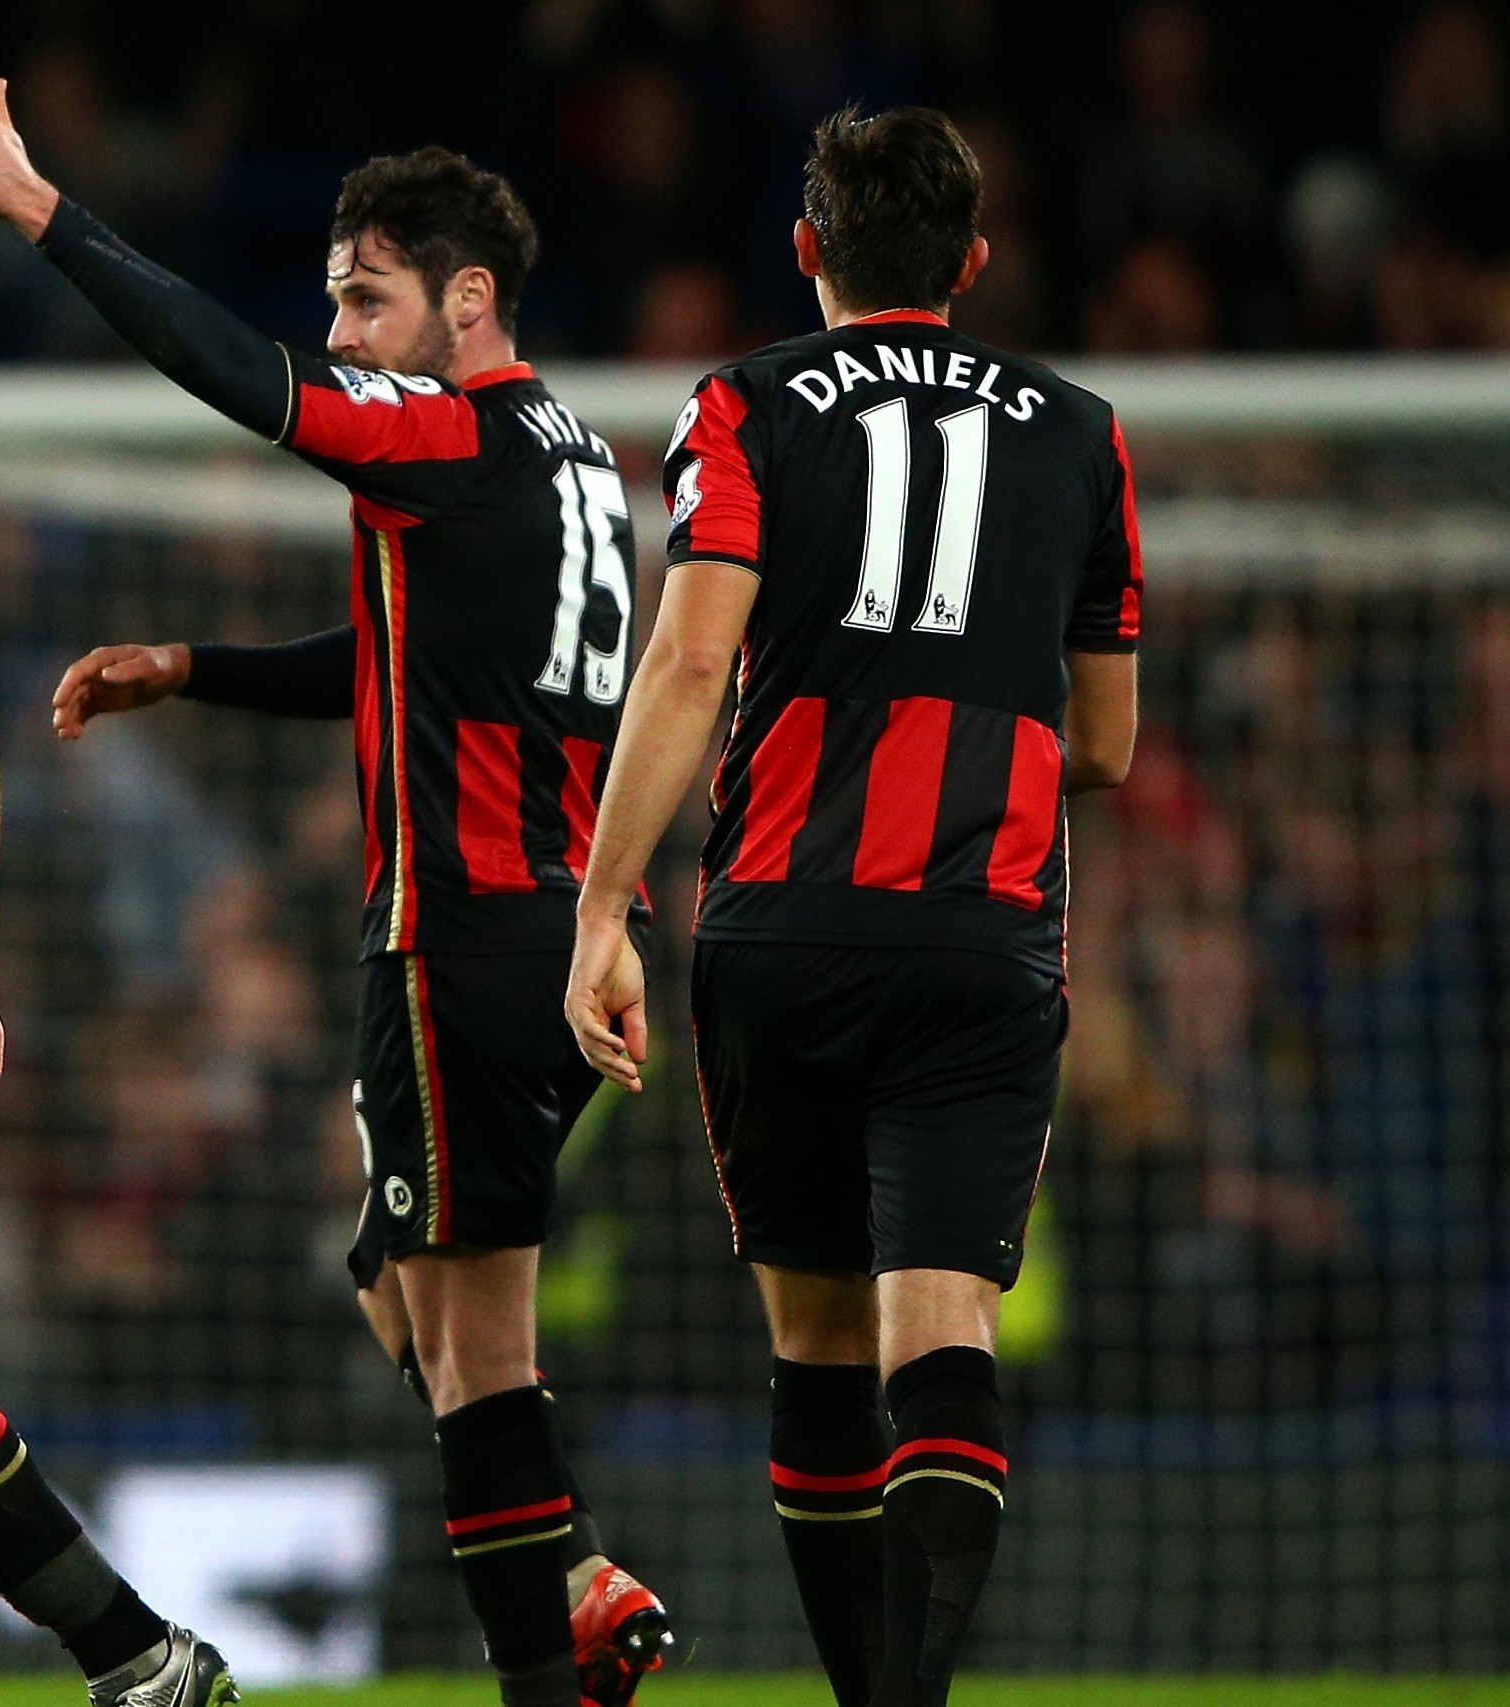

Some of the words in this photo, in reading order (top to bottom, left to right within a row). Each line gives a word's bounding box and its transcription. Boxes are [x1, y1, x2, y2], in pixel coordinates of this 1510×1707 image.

[786, 344, 1045, 422] DANIELS
[533, 459, 630, 705] 15
[841, 397, 989, 635] 11
